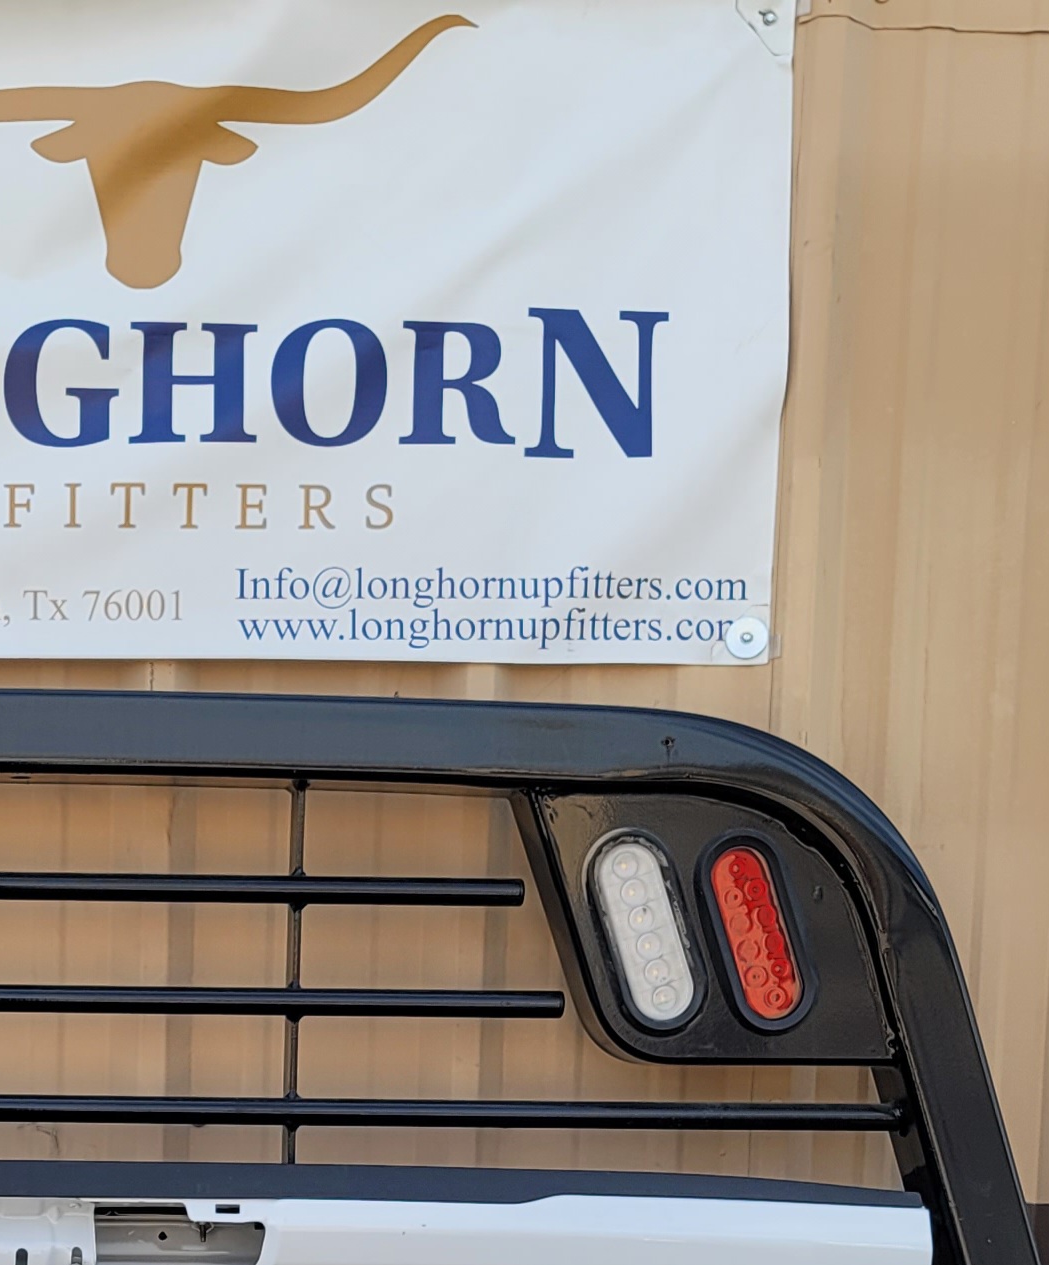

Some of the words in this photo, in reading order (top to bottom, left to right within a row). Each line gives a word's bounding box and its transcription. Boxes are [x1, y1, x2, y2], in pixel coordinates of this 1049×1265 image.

[22, 589, 70, 622] Tx
[81, 589, 184, 622] 76001
[235, 566, 749, 609] Info@longhornupfitters.com
